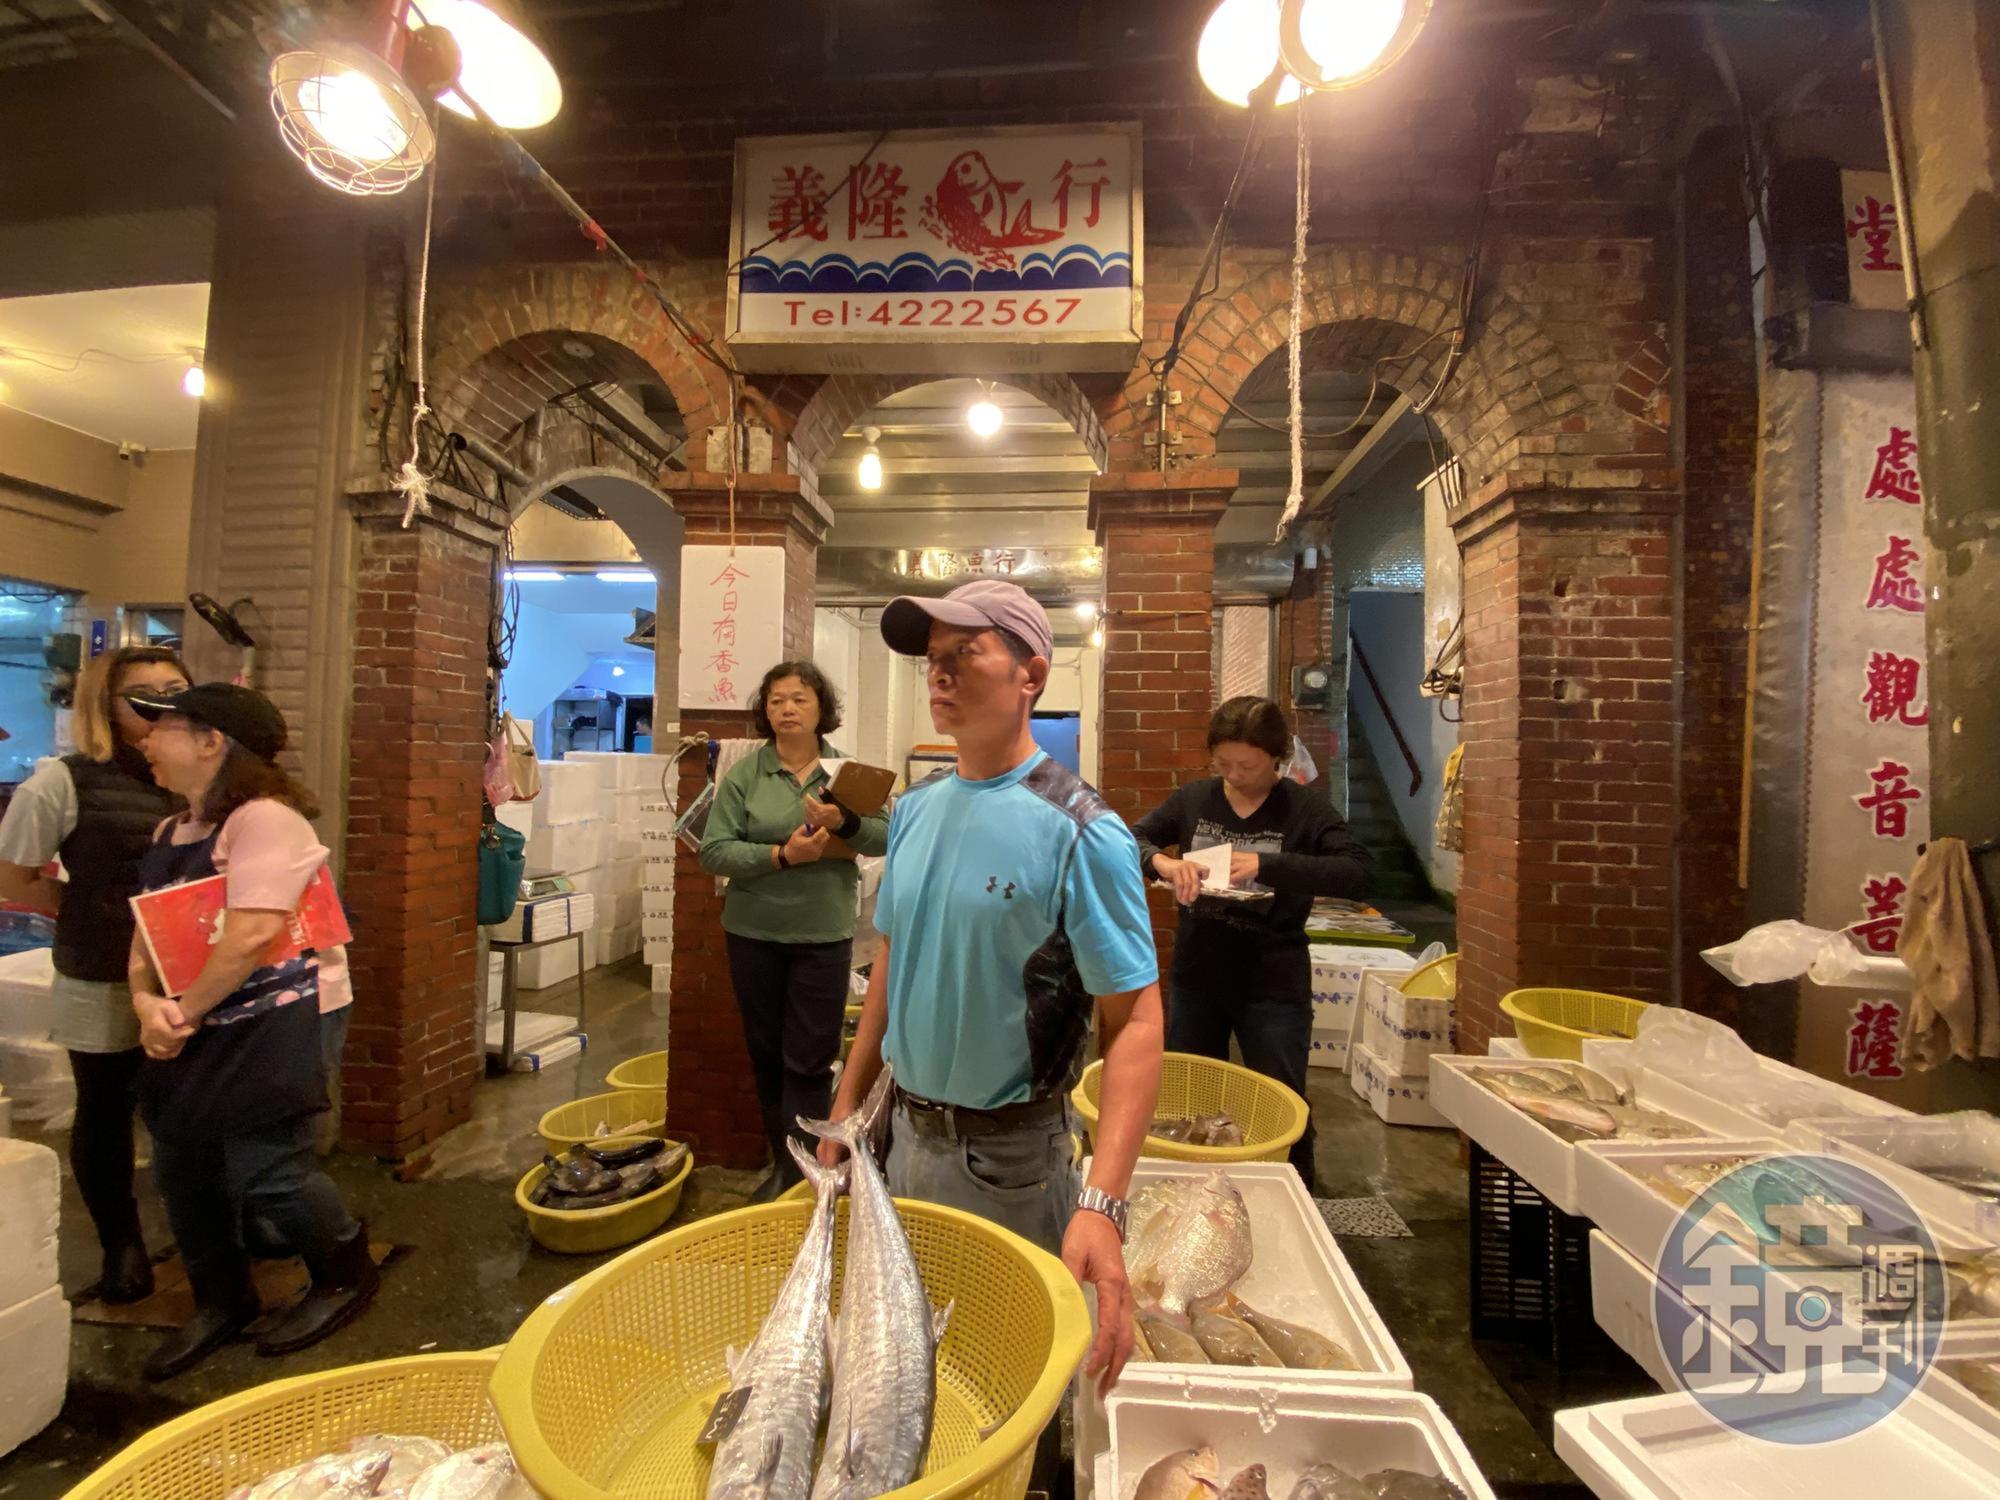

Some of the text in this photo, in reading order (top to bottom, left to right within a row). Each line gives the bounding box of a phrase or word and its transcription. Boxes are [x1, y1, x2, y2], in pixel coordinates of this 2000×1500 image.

[768, 158, 1111, 242] 義隆 行
[1846, 195, 1904, 271] 堂
[784, 299, 1082, 326] Tel:4222567
[704, 563, 750, 703] 今日有香魚
